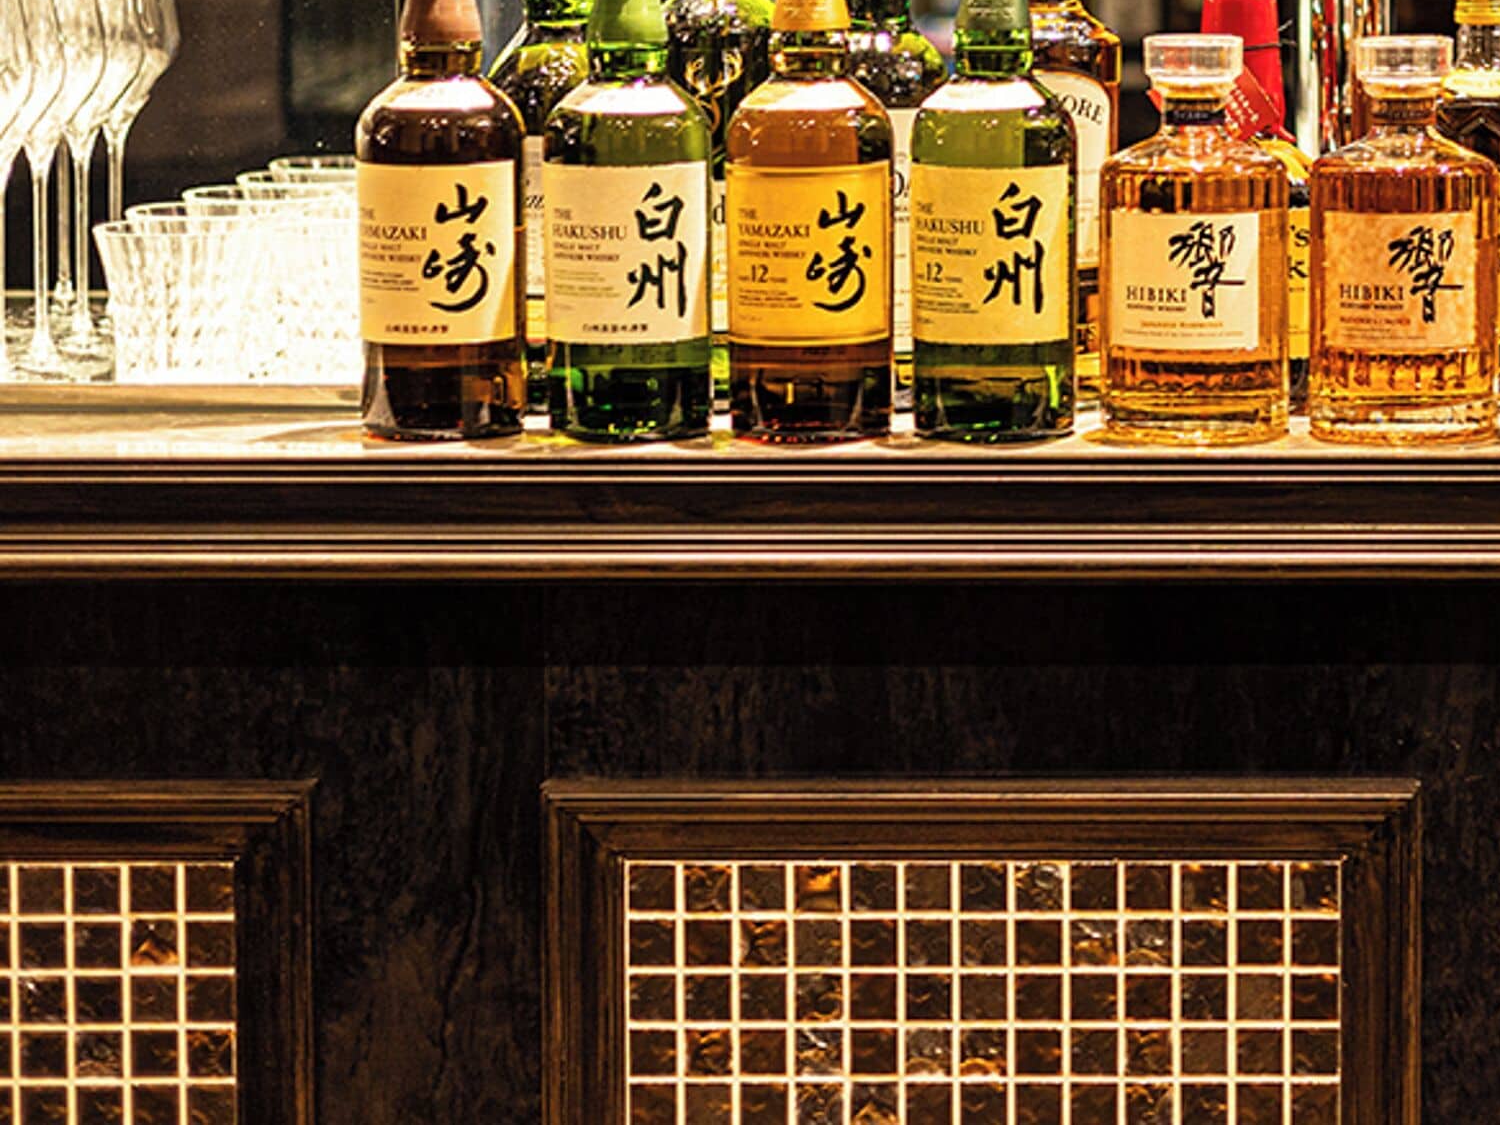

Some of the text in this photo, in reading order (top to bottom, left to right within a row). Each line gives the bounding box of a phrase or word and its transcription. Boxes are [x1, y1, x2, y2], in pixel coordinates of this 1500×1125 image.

[1061, 94, 1104, 125] ORE
[627, 182, 688, 317] 白州
[983, 182, 1045, 314] 白州
[751, 263, 769, 284] 12
[926, 262, 943, 283] 12
[1126, 285, 1187, 303] HIBIKI
[1339, 284, 1404, 301] HIBIKI
